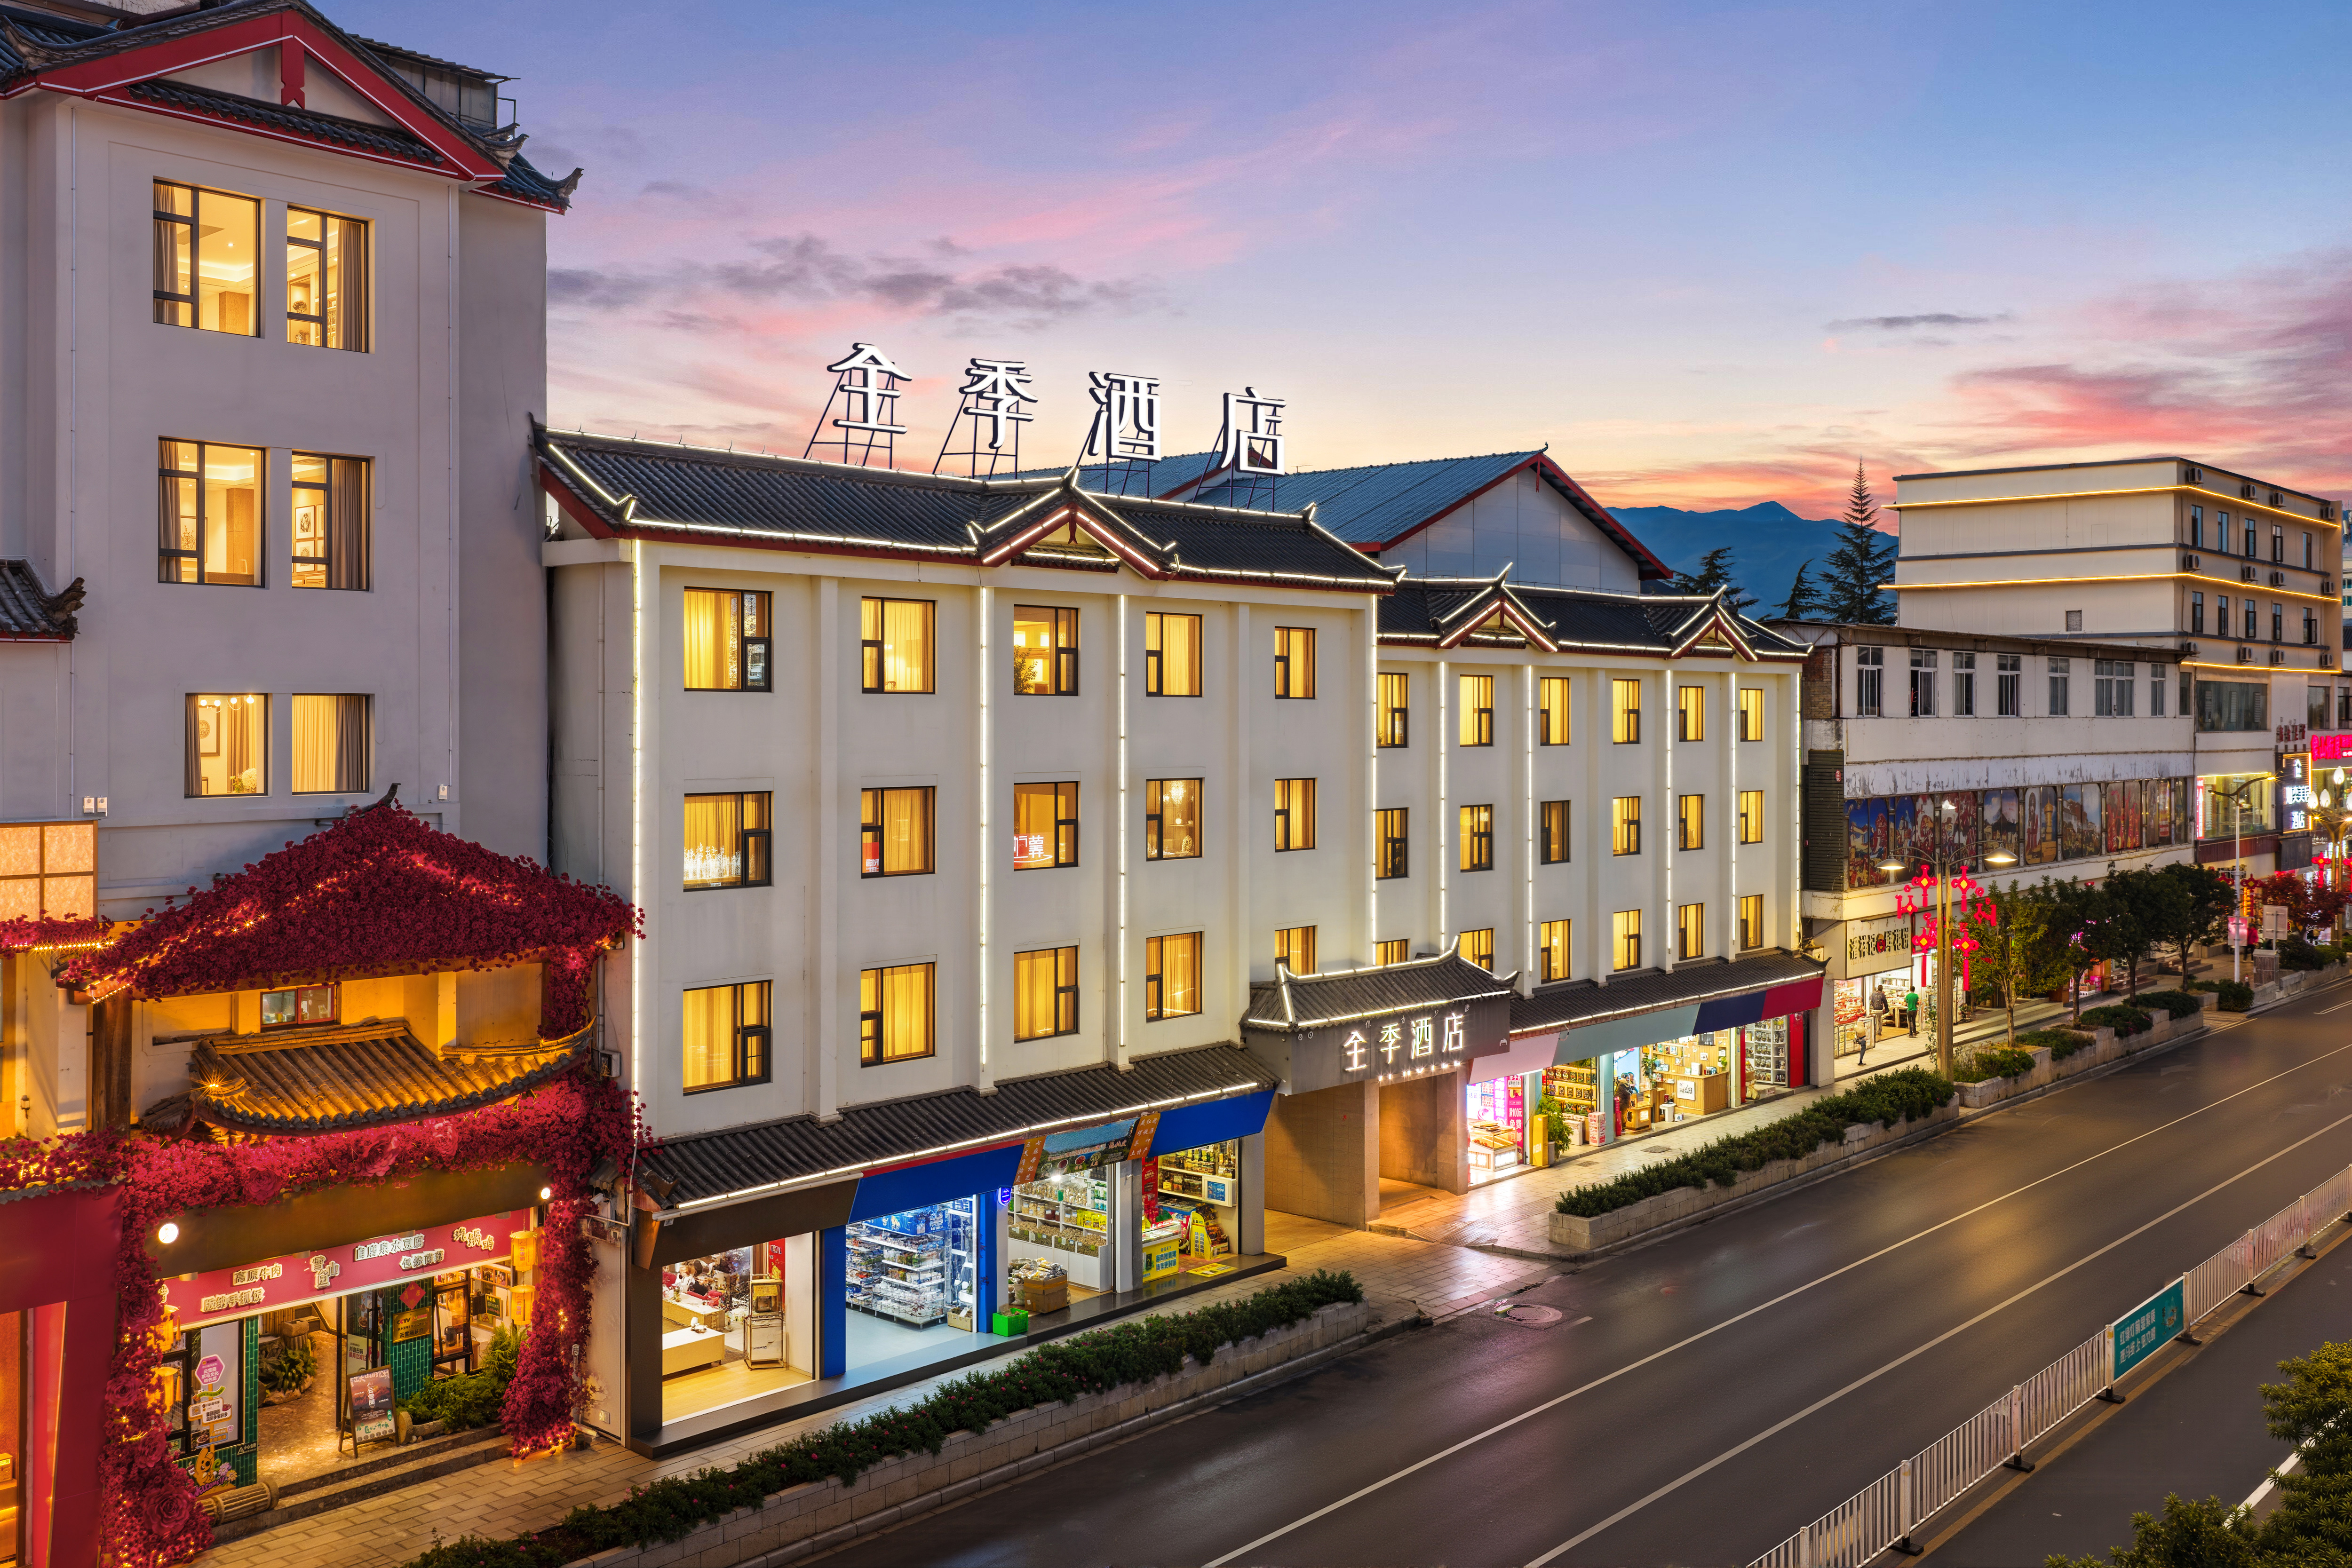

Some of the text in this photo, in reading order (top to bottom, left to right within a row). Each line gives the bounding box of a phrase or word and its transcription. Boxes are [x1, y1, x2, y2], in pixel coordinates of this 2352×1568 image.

[826, 342, 1286, 476] 全季酒店
[2292, 810, 2305, 829] 酒店
[1343, 1013, 1463, 1071] 全季酒店
[1509, 1108, 1522, 1117] 满100元
[1509, 1119, 1522, 1130] 免费
[1130, 1147, 1148, 1156] 土特产
[355, 1234, 425, 1261] 自磨泉水豆腐
[453, 1227, 494, 1251] 汽锅鸡
[233, 1263, 282, 1286] 高原牛肉
[201, 1286, 265, 1313] 版纳手抓饭
[349, 1346, 364, 1354] 抖音扫码
[201, 1371, 219, 1379] 茶马文化
